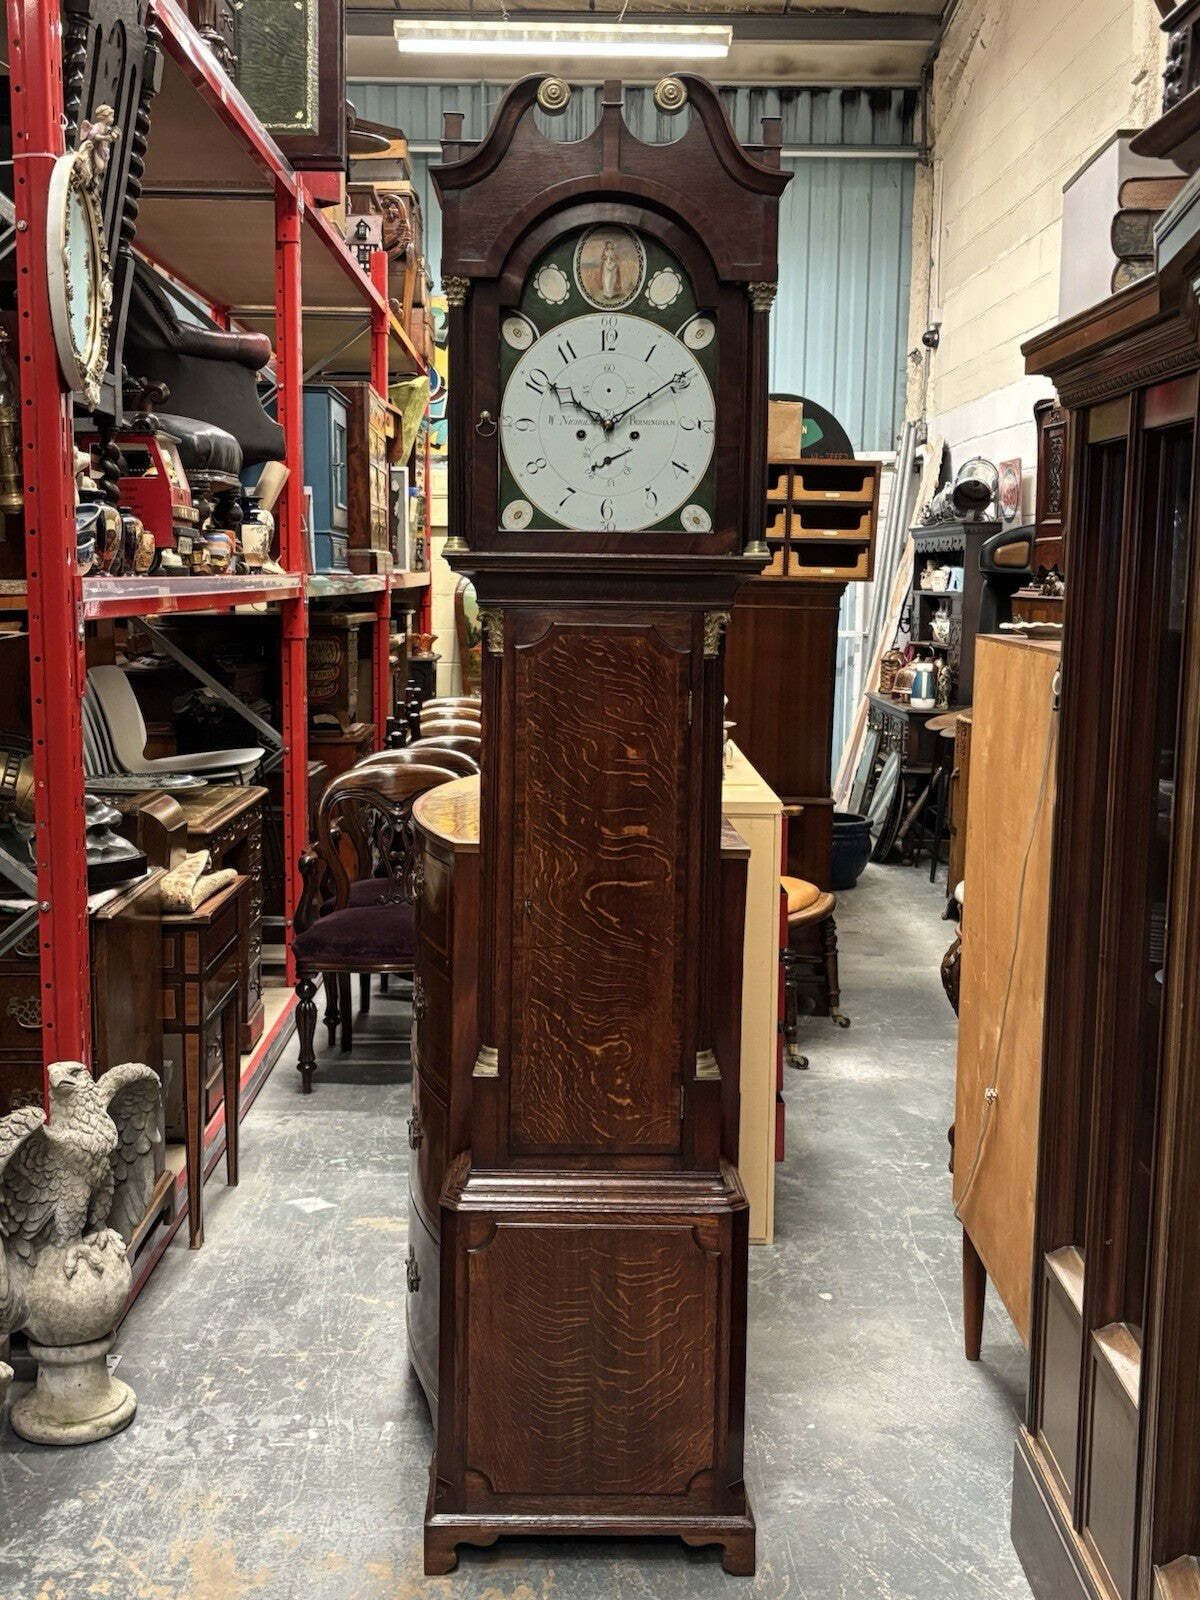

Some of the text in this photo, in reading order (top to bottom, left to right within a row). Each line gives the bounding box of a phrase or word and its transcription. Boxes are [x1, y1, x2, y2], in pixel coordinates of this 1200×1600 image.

[602, 330, 618, 351] 12
[558, 340, 577, 364] 11
[525, 368, 550, 395] 10
[515, 418, 536, 432] 9
[526, 457, 547, 475] 8
[559, 487, 577, 506] 7
